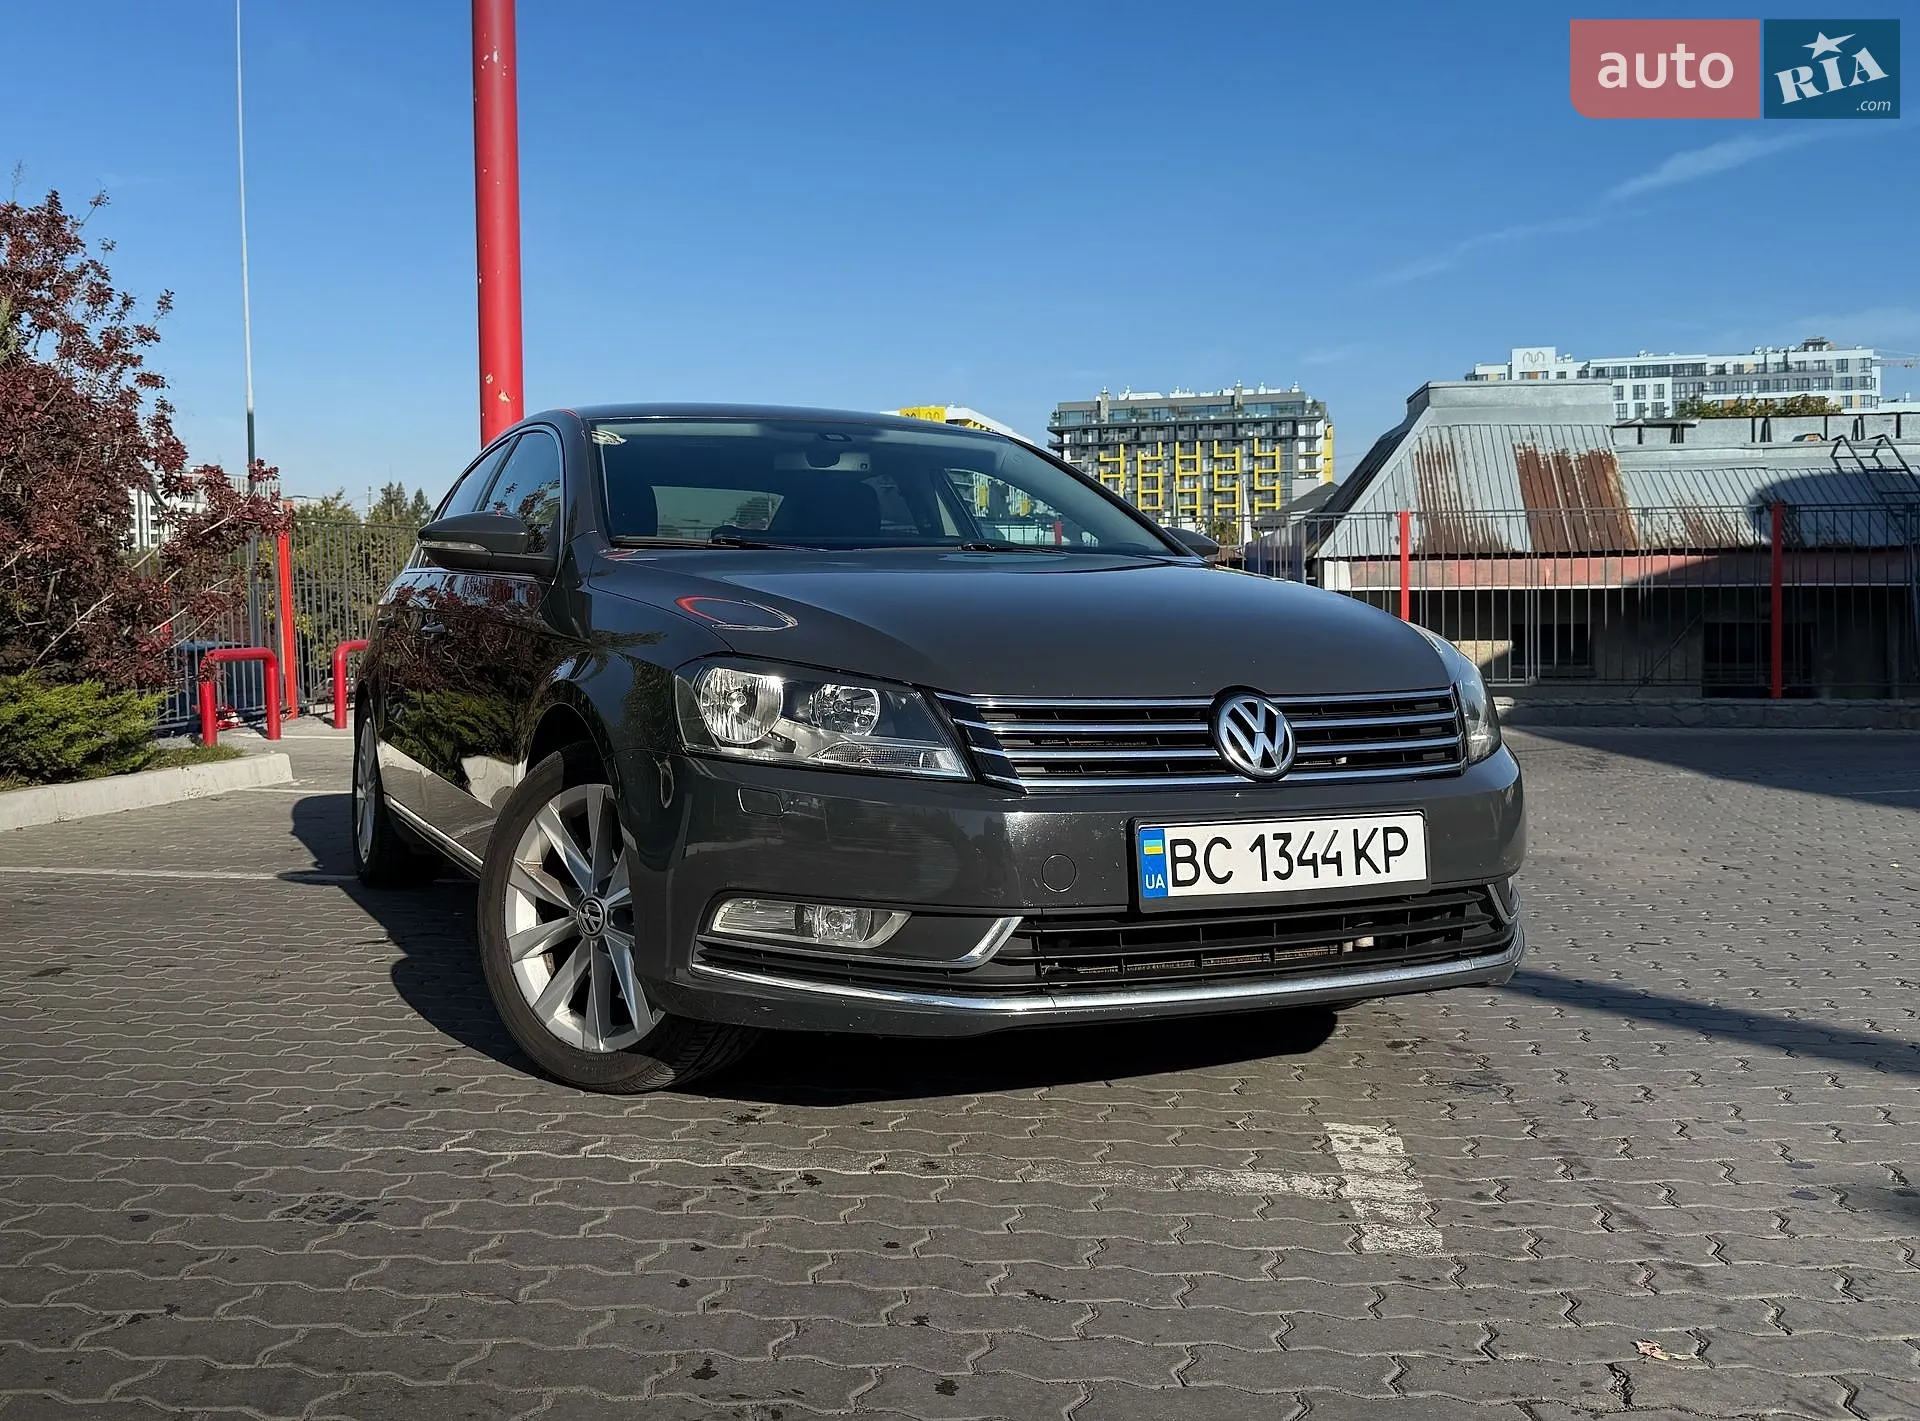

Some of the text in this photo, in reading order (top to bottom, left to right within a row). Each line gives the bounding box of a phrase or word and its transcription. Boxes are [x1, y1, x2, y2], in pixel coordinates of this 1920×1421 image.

[1169, 826, 1409, 887] BC 1344 KP
[1145, 873, 1166, 890] UA
